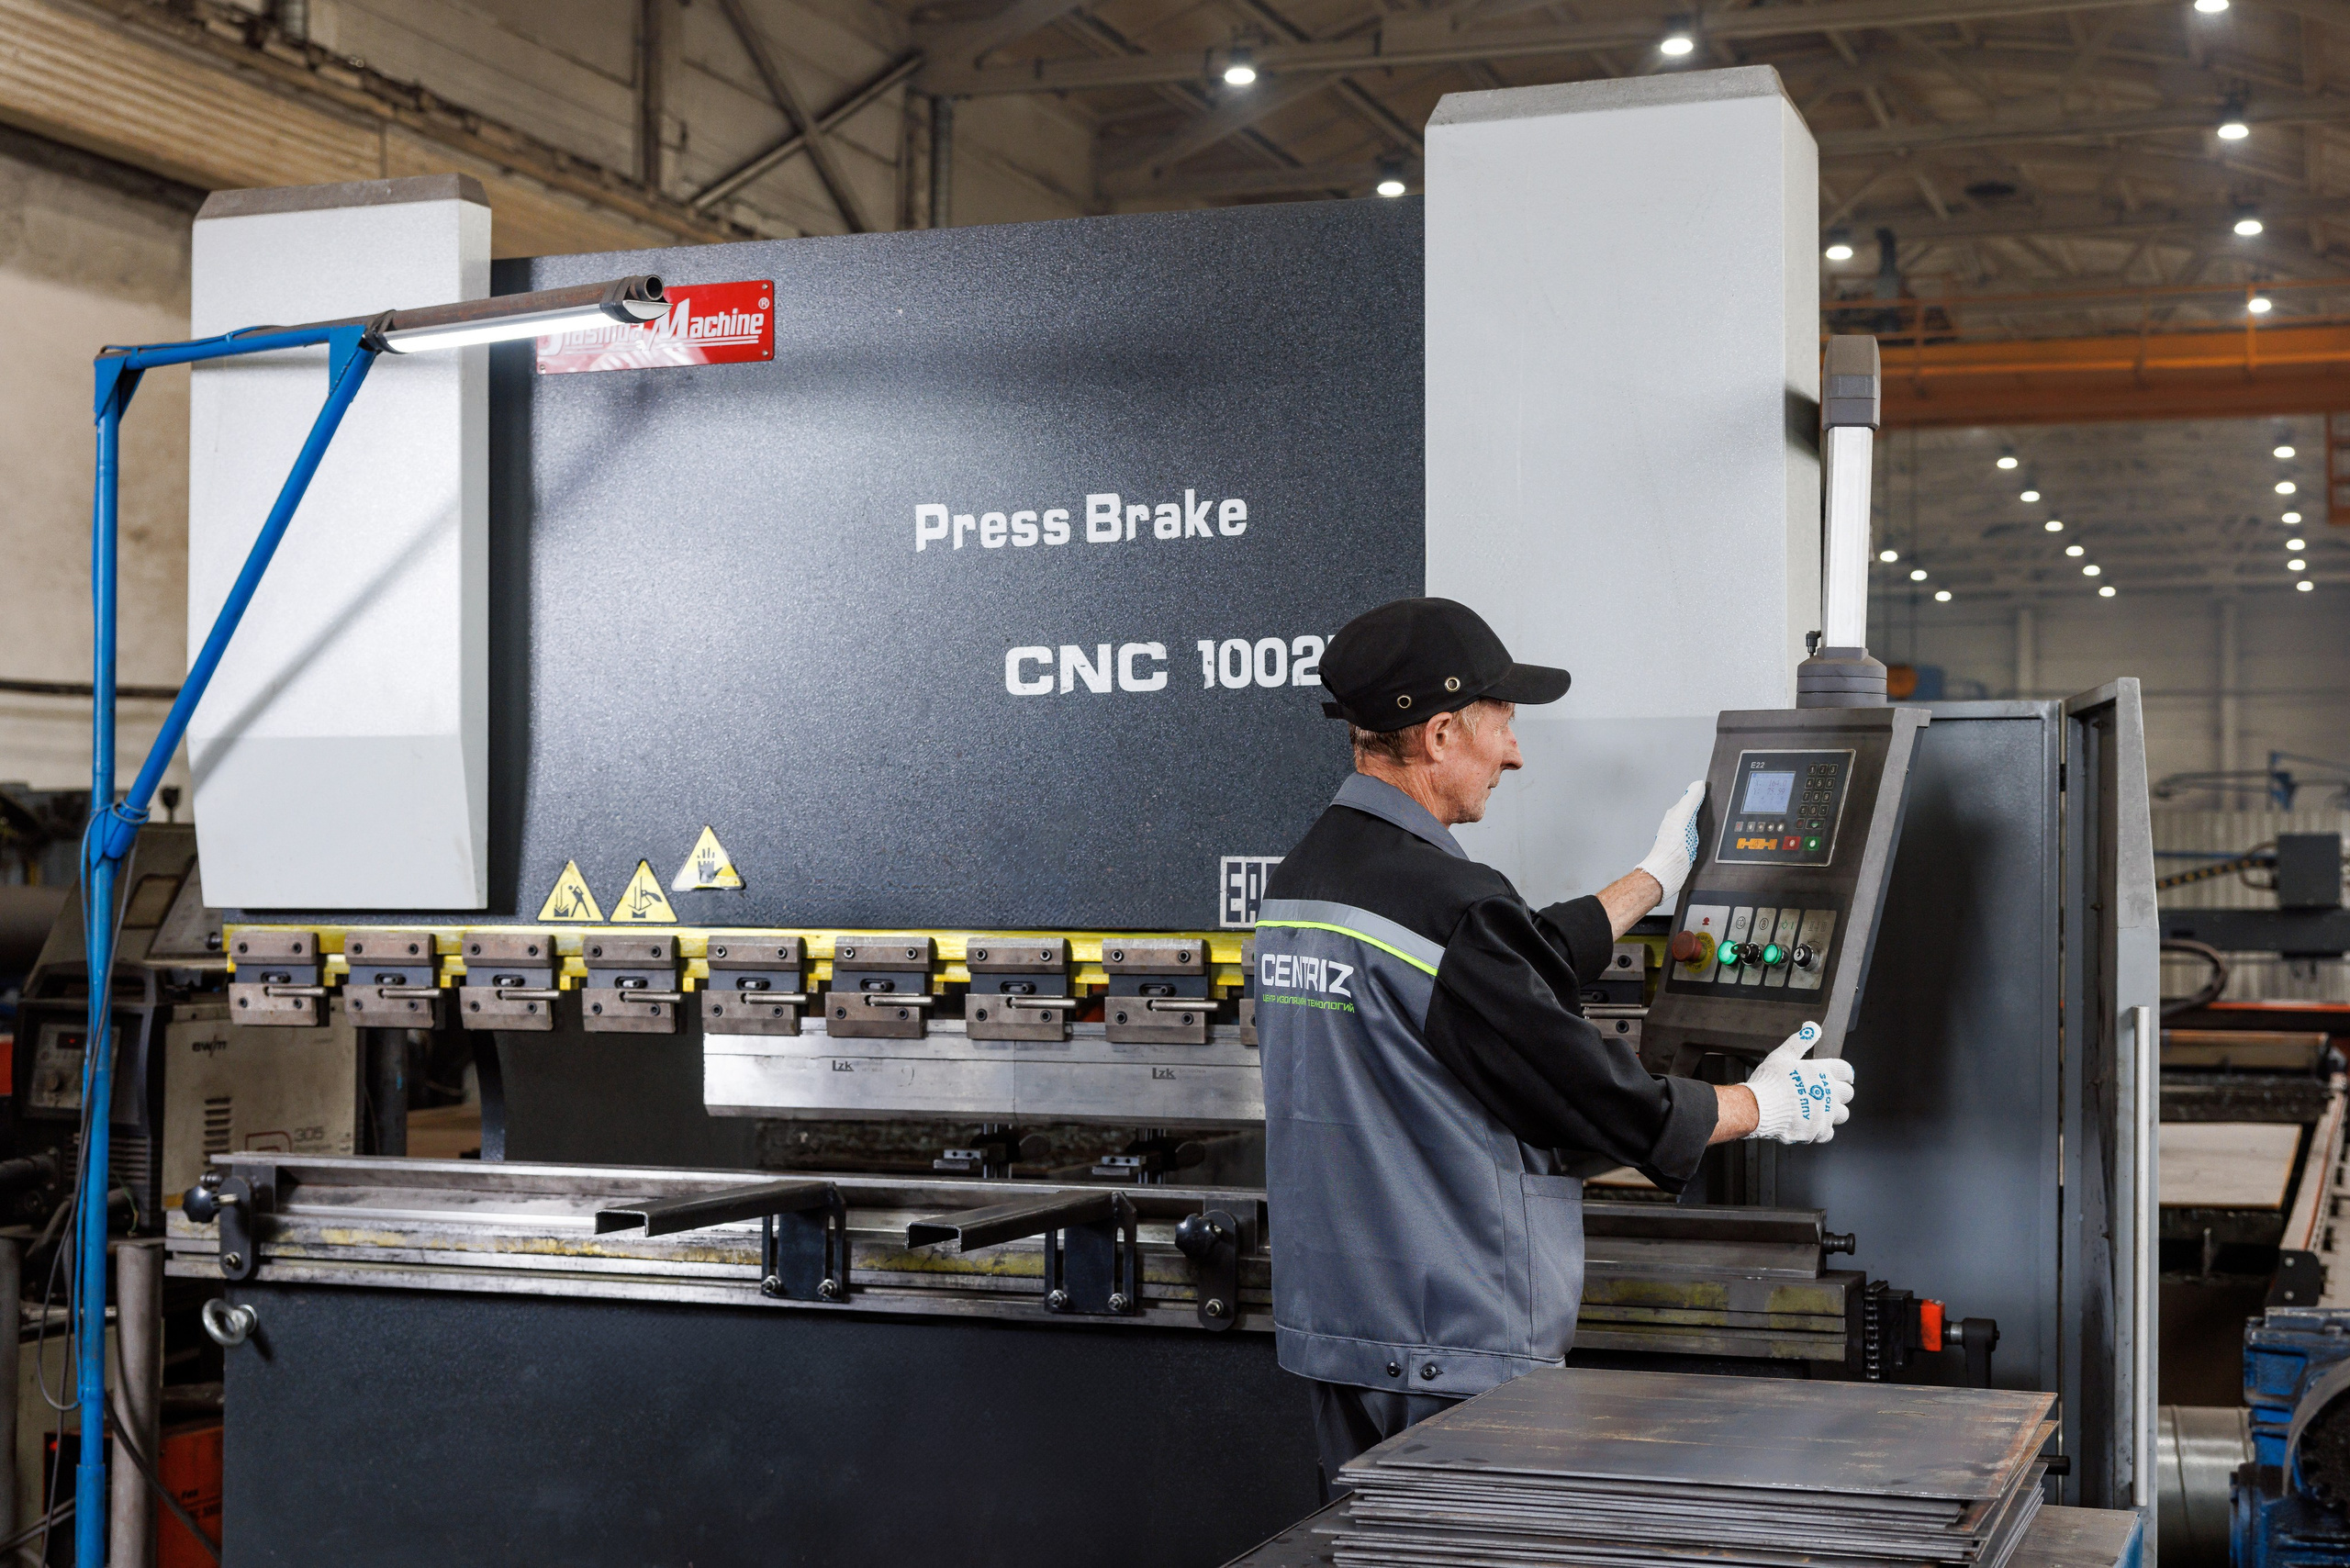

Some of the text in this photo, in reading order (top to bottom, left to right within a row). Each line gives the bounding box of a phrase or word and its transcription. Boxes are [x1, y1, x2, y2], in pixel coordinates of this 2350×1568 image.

[646, 298, 764, 351] Machine
[915, 488, 1248, 552] Press Brake
[1005, 634, 1335, 696] CNC 1002
[1225, 861, 1280, 923] EA
[1261, 954, 1354, 998] CENTRIZ
[832, 1059, 855, 1072] Lzk
[1152, 1067, 1177, 1080] Lzk
[1789, 1070, 1810, 1120] ТРУБ ППУ
[1819, 1072, 1831, 1112] ЗАВОД
